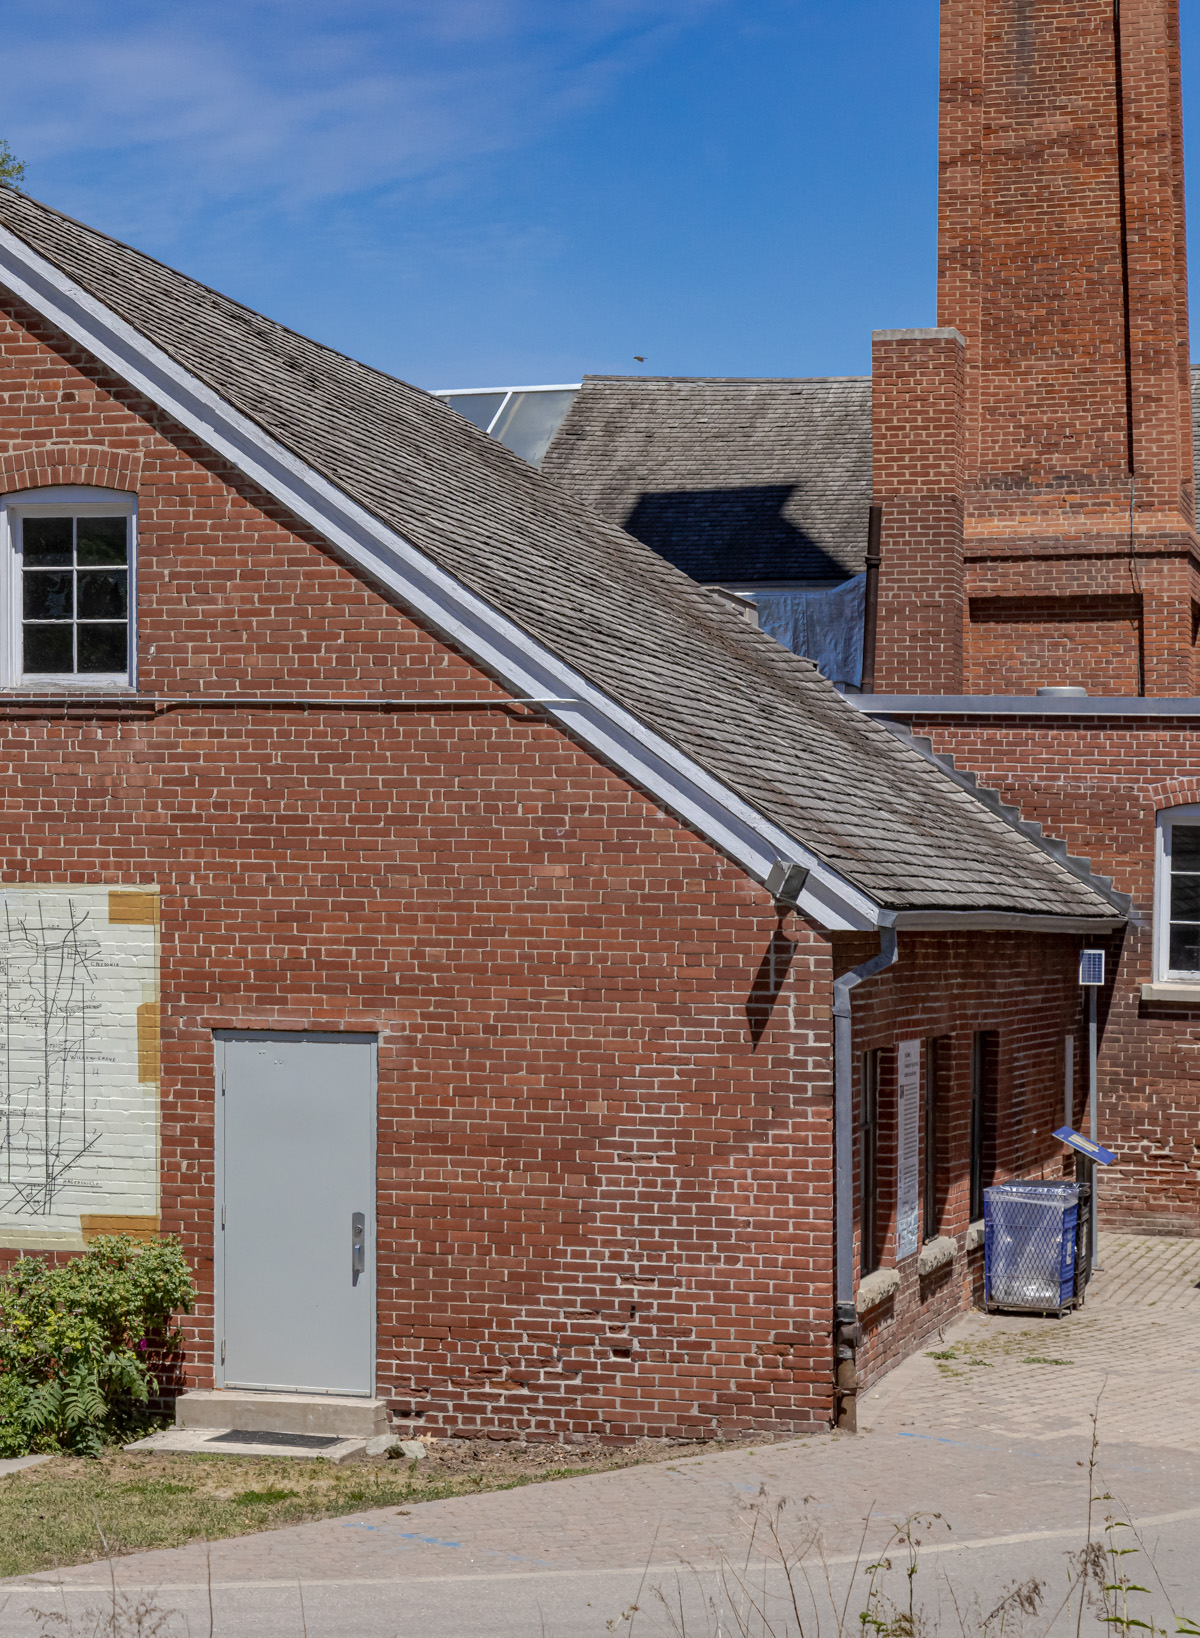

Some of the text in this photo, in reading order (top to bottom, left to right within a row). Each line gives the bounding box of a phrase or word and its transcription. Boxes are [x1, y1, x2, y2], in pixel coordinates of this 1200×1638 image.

[91, 991, 97, 1001] 6
[92, 1067, 100, 1077] 4
[92, 1098, 98, 1109] 3
